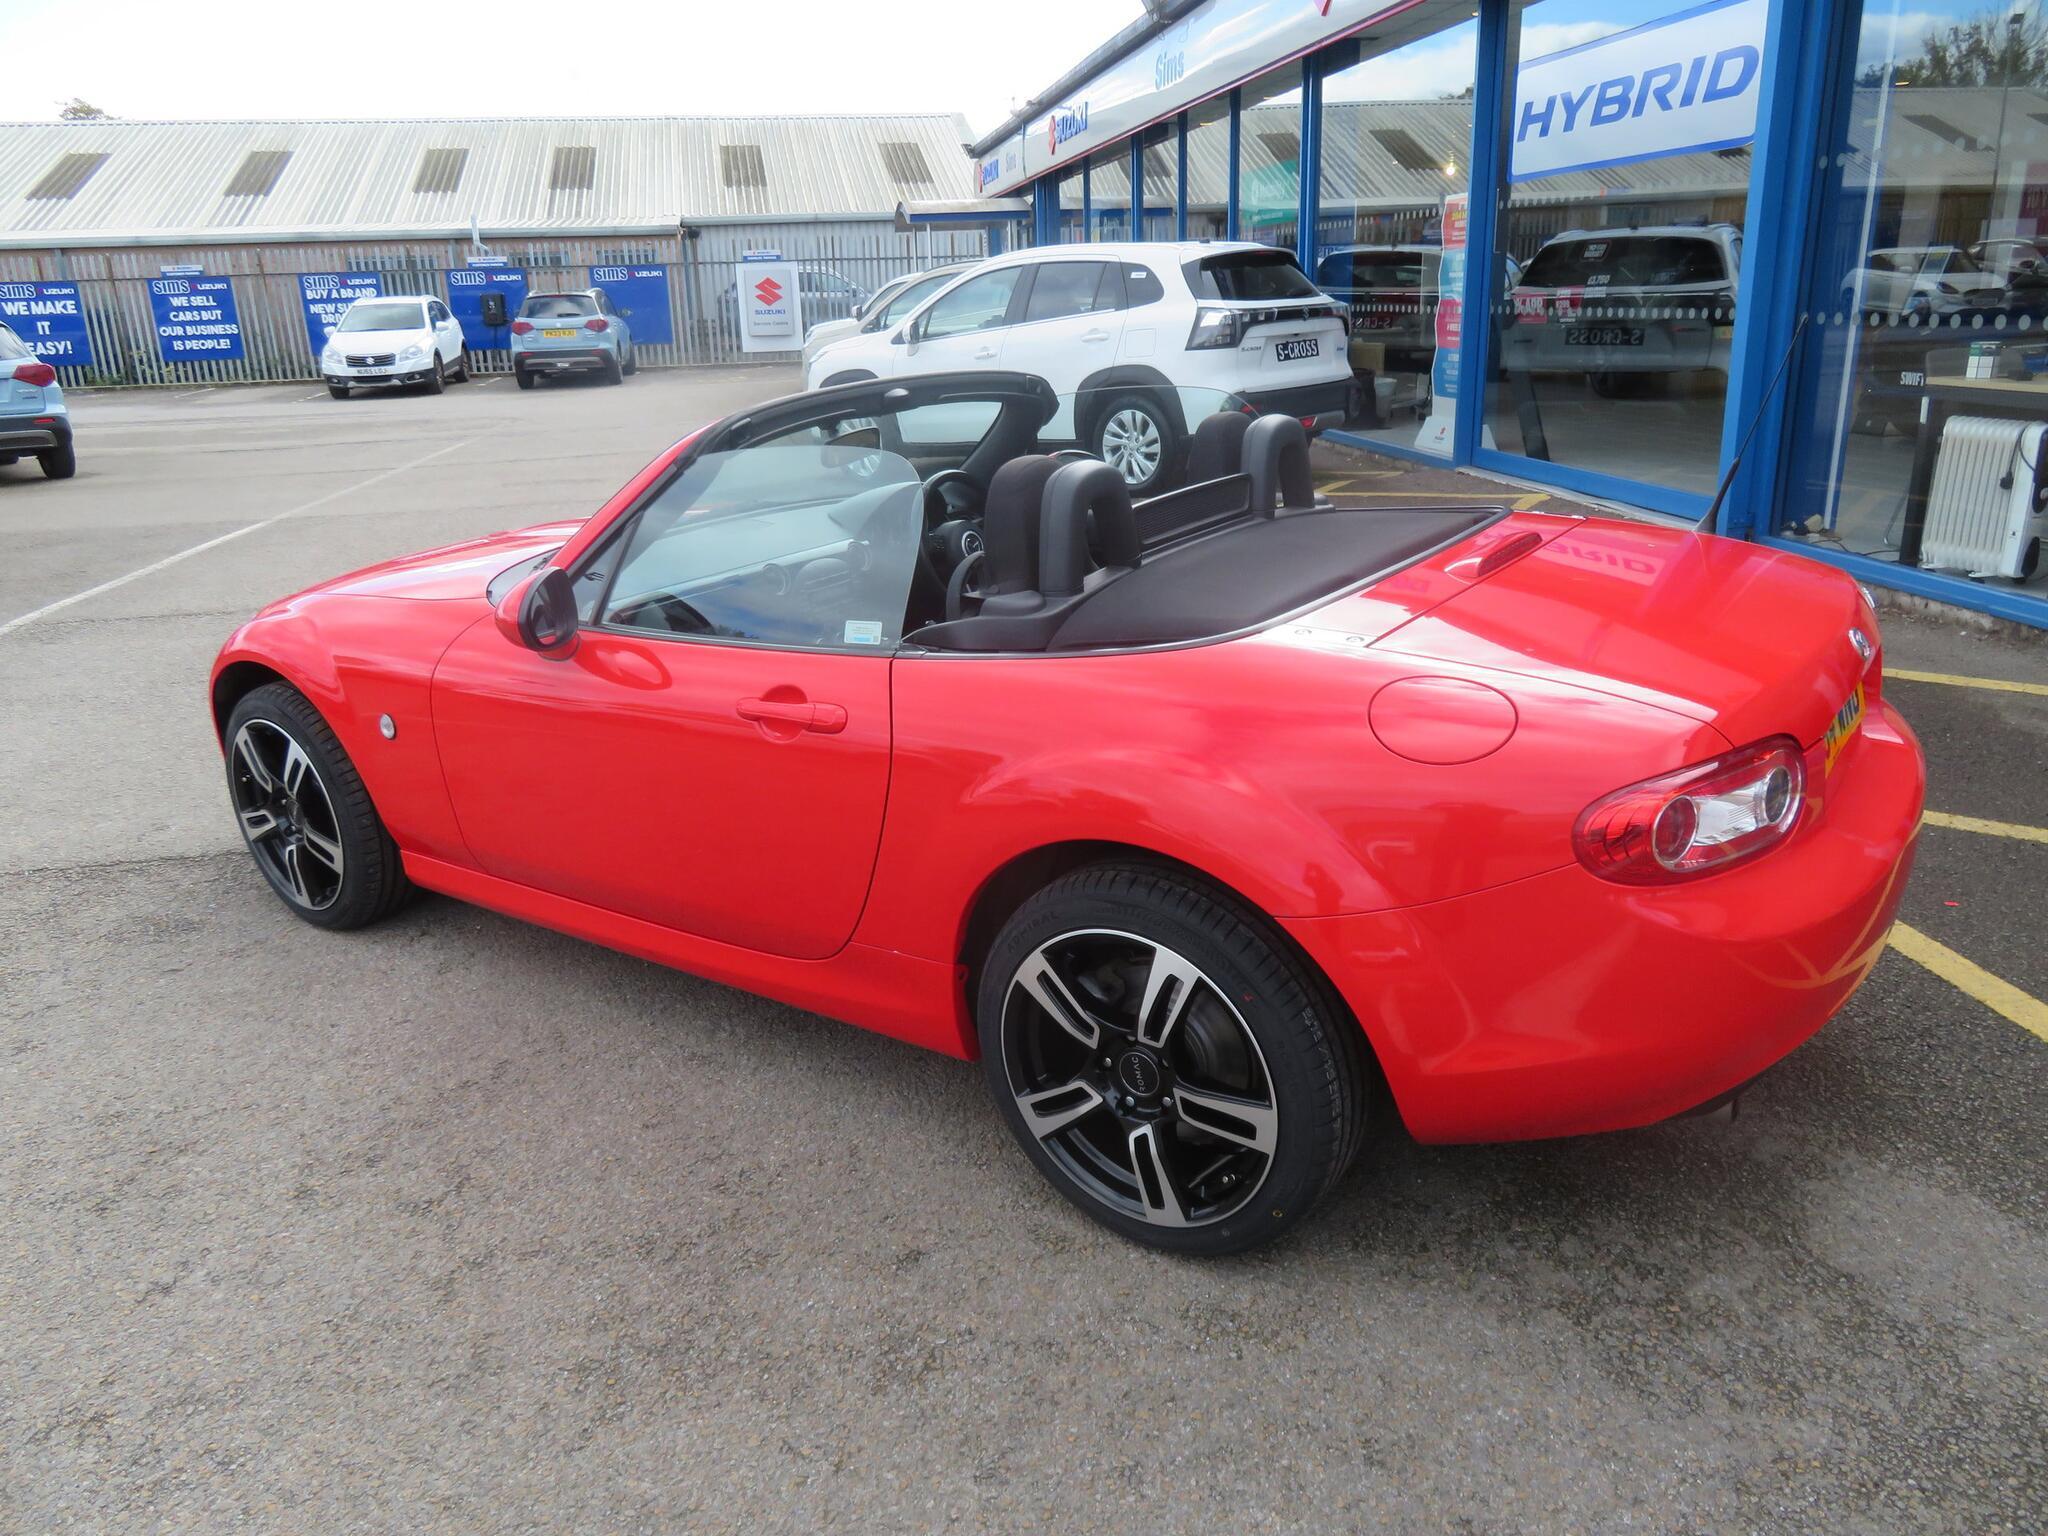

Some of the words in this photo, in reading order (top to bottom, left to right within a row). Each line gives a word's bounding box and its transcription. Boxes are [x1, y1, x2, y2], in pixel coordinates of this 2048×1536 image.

[1517, 45, 1760, 142] HYBRID
[305, 288, 330, 300] BUY
[331, 289, 342, 299] A
[341, 287, 378, 299] BRAND
[168, 296, 190, 307] WE
[190, 295, 218, 306] SELL
[1, 301, 30, 316] WE
[30, 300, 78, 315] MAKE
[309, 303, 336, 314] NEW
[754, 308, 786, 316] SUZUKI
[169, 311, 200, 322] CARS
[201, 310, 223, 321] BUT
[36, 320, 51, 335] IT
[159, 326, 186, 337] OUR
[185, 324, 239, 336] BUSINESS
[25, 340, 73, 356] EASY!
[173, 340, 185, 351] IS
[185, 339, 232, 350] PEOPLE!
[1278, 340, 1318, 360] S-CROSS
